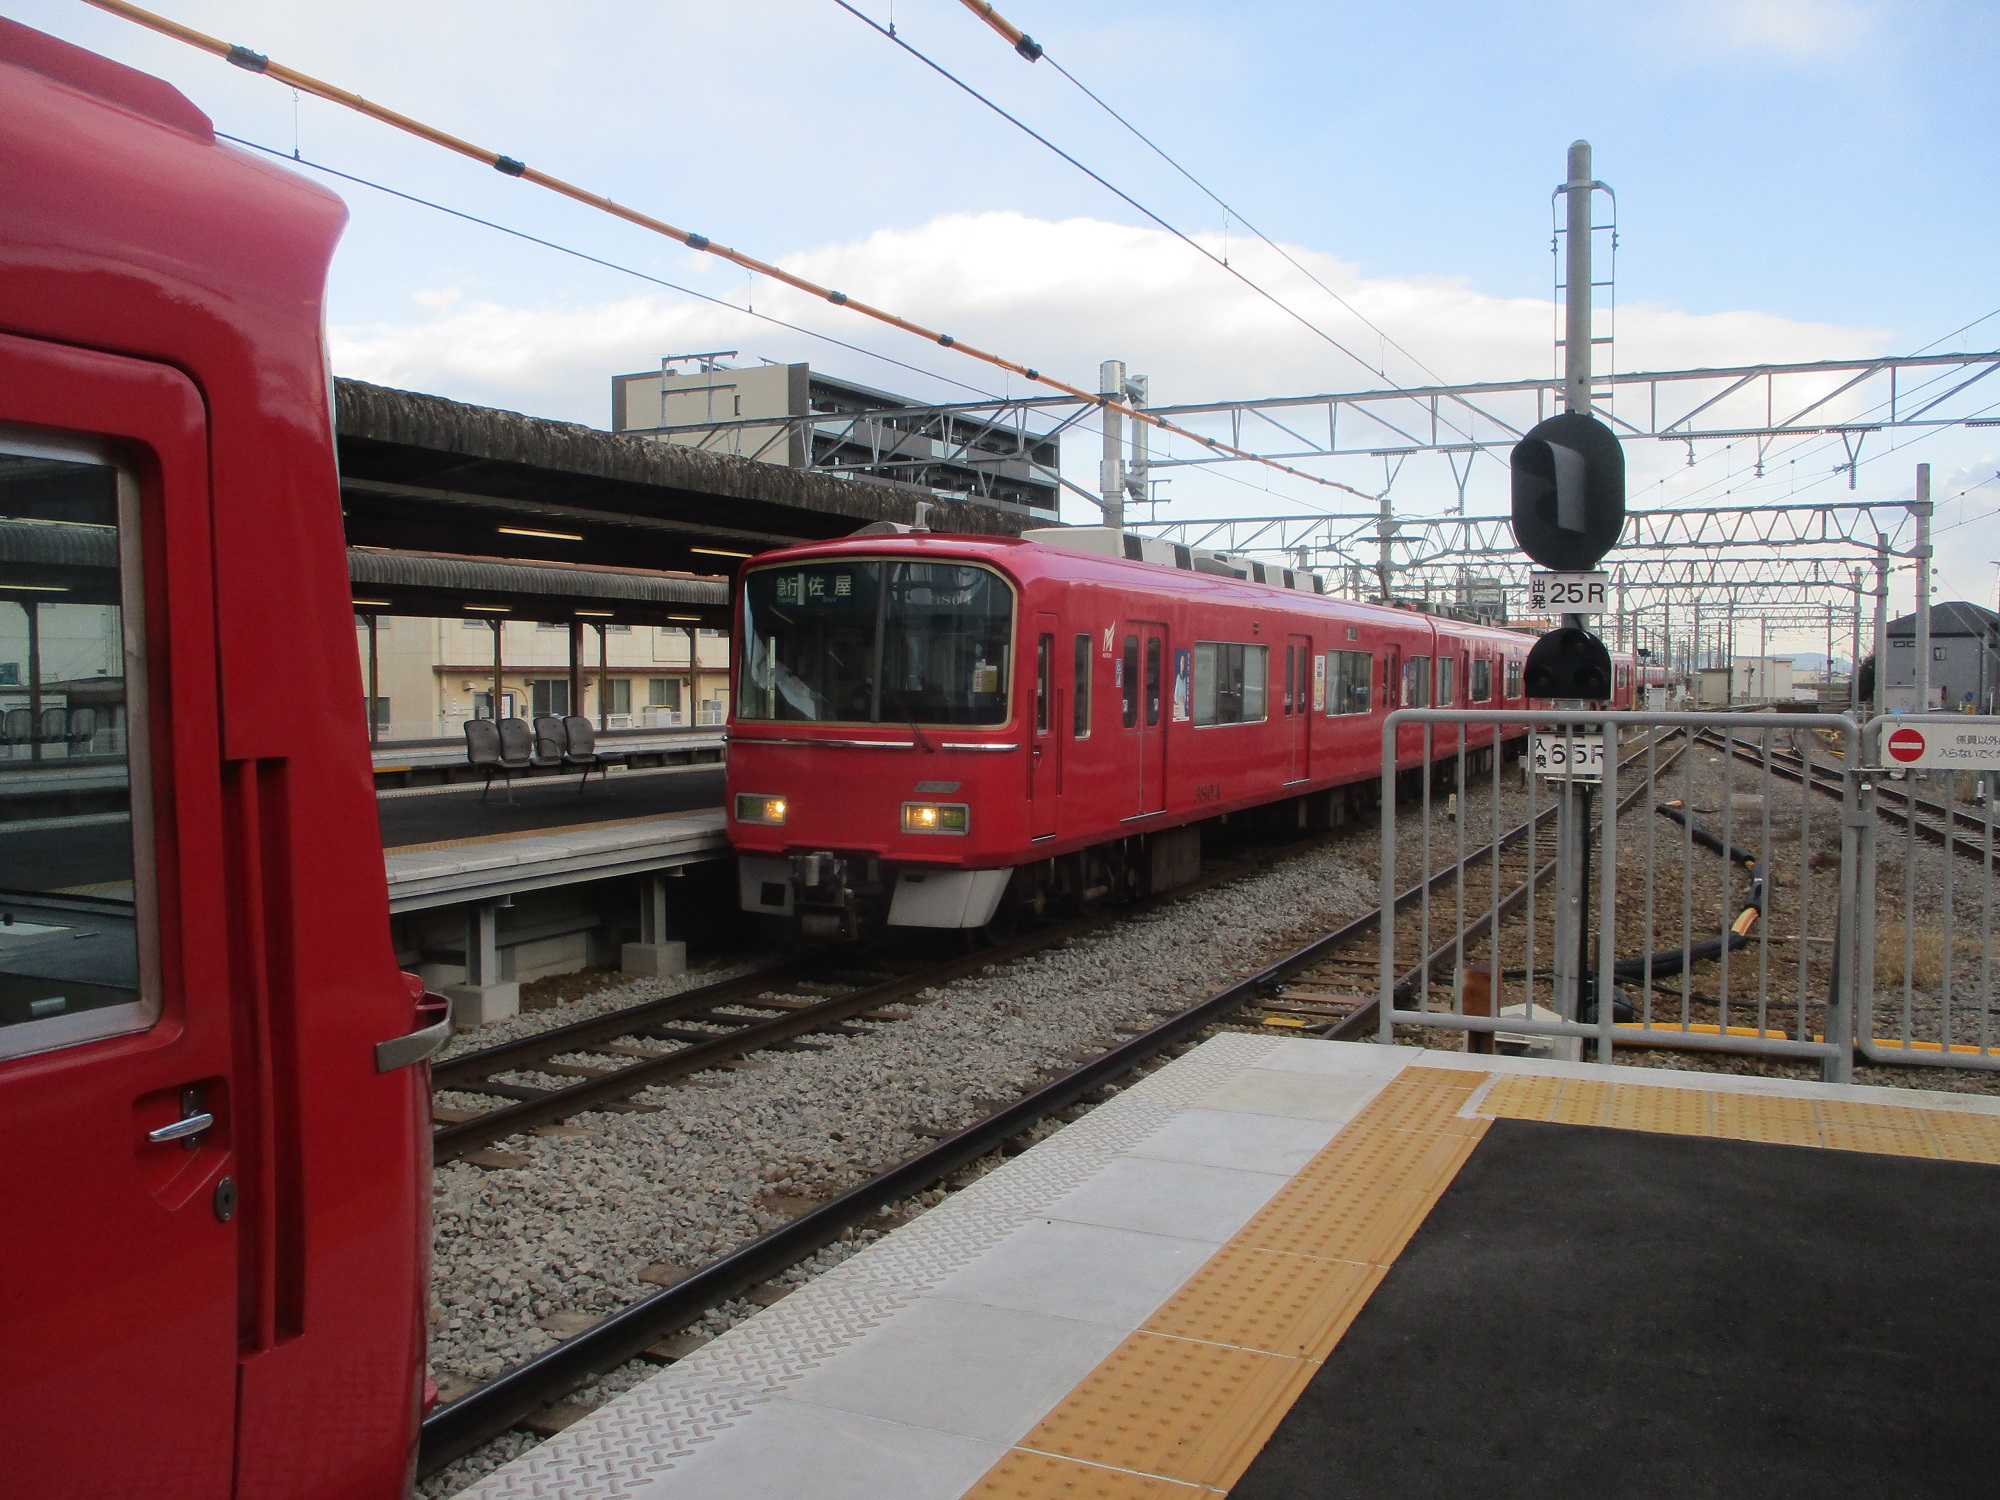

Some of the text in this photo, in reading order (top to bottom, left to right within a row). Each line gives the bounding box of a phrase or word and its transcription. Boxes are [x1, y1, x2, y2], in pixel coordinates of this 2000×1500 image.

[776, 575, 851, 596] 急行 佐屋
[1531, 578, 1605, 609] 出発 25R
[1956, 734, 2000, 746] 係員以外
